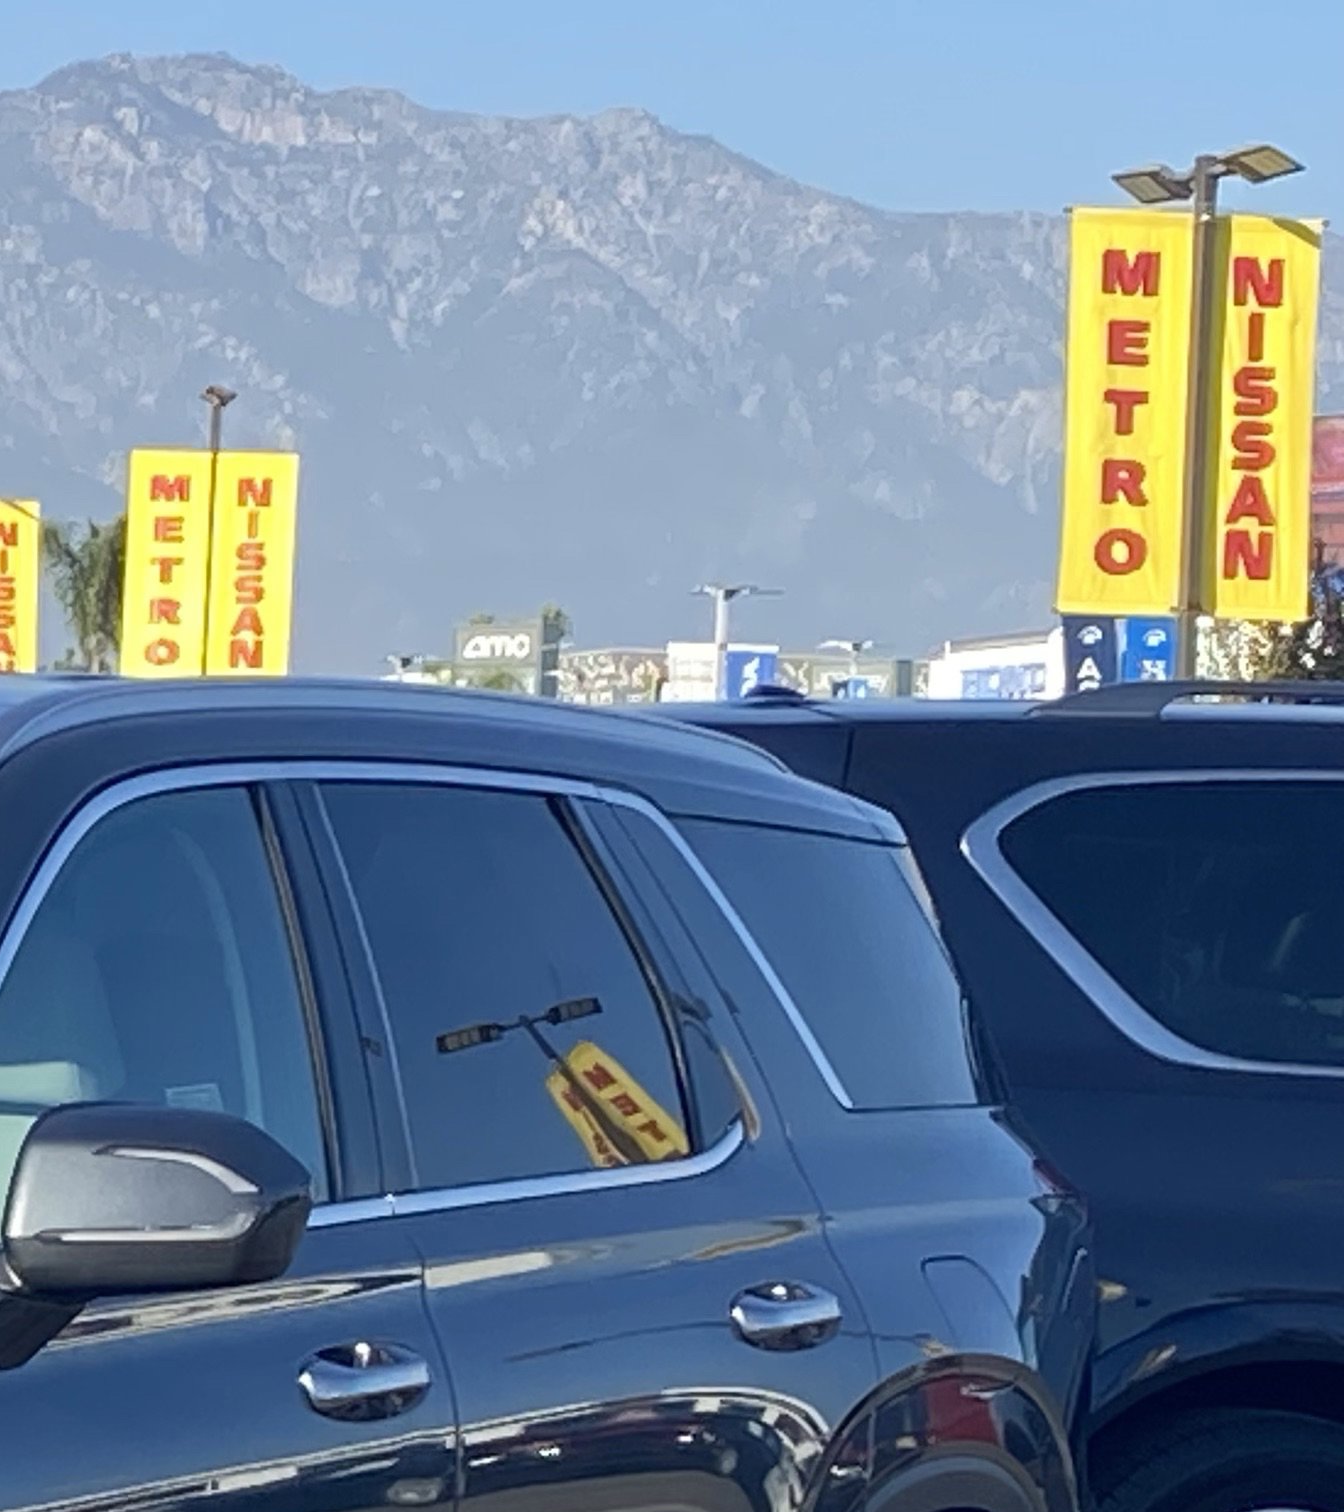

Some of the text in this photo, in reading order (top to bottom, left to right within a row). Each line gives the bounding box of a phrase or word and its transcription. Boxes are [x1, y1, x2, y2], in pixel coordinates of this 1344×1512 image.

[1094, 249, 1161, 576] METRO
[1223, 256, 1285, 581] NISSAN
[144, 475, 191, 665] METRO
[229, 477, 273, 668] NISSAN
